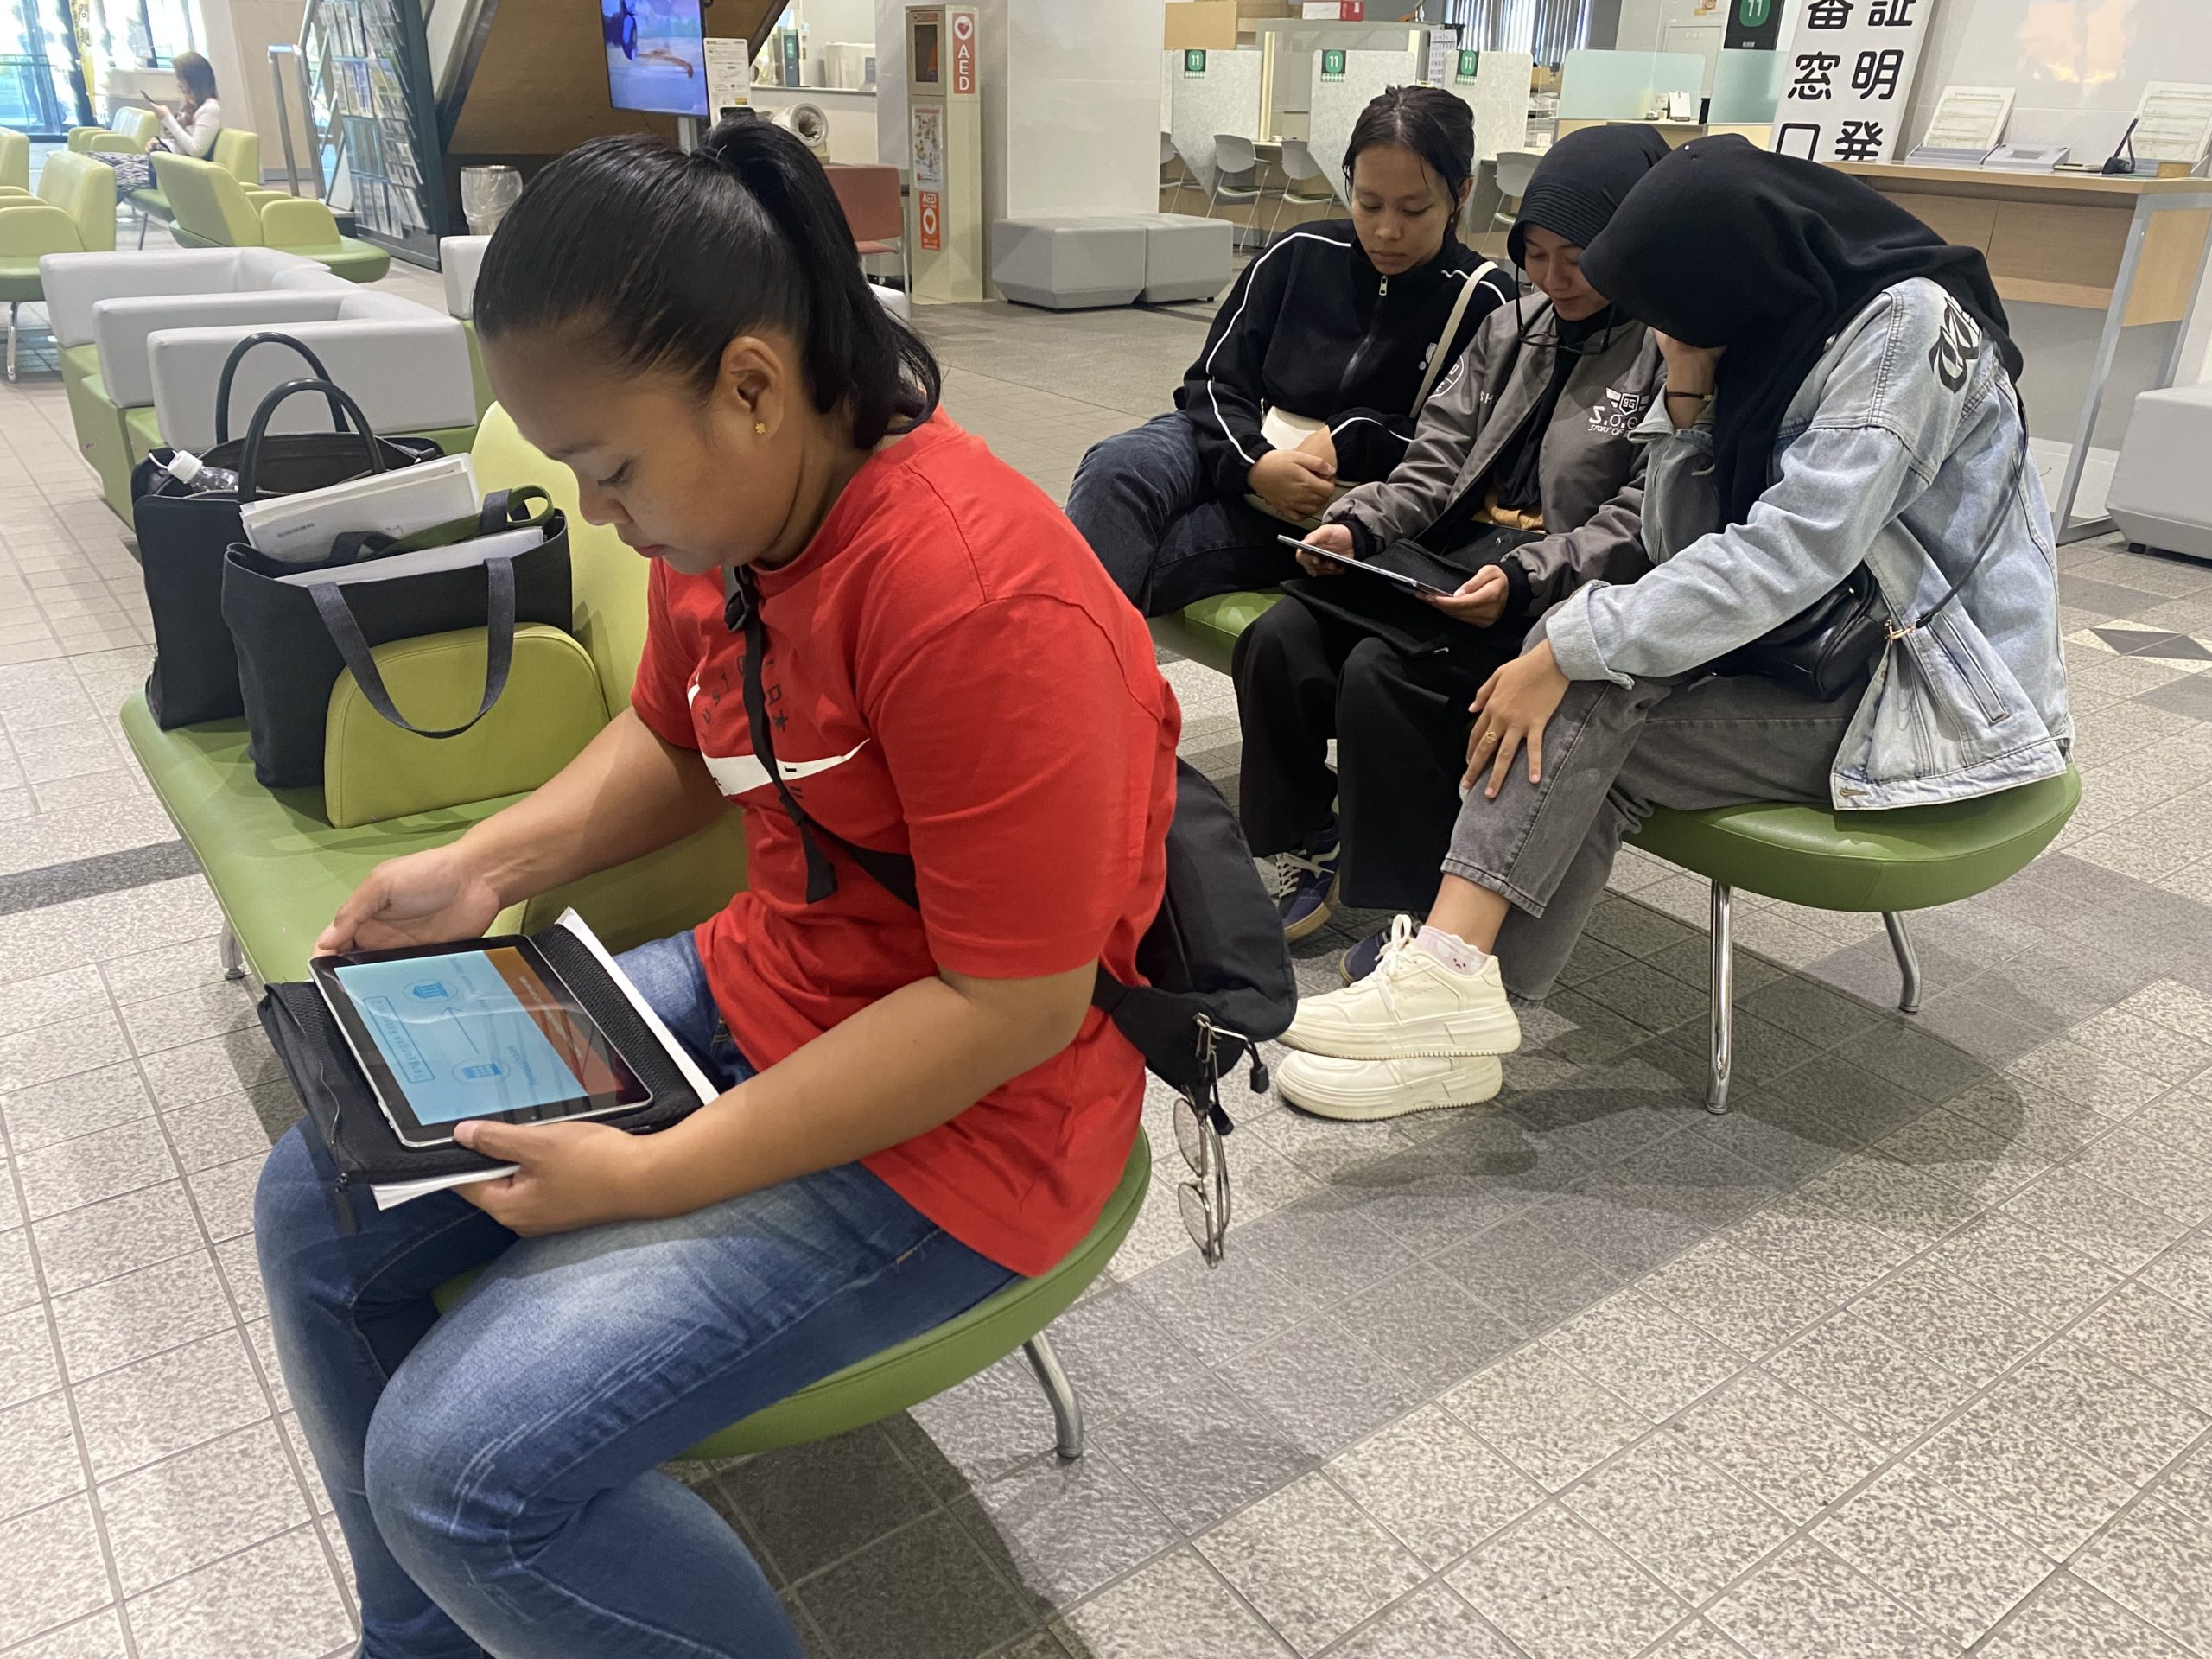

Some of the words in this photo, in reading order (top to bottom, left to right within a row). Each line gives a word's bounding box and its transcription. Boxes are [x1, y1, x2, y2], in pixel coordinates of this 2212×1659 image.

[1748, 0, 1763, 17] 11
[1191, 54, 1200, 67] 11
[1329, 55, 1339, 67] 11
[1465, 56, 1473, 69] 11
[957, 44, 970, 91] AED
[922, 193, 937, 204] AED
